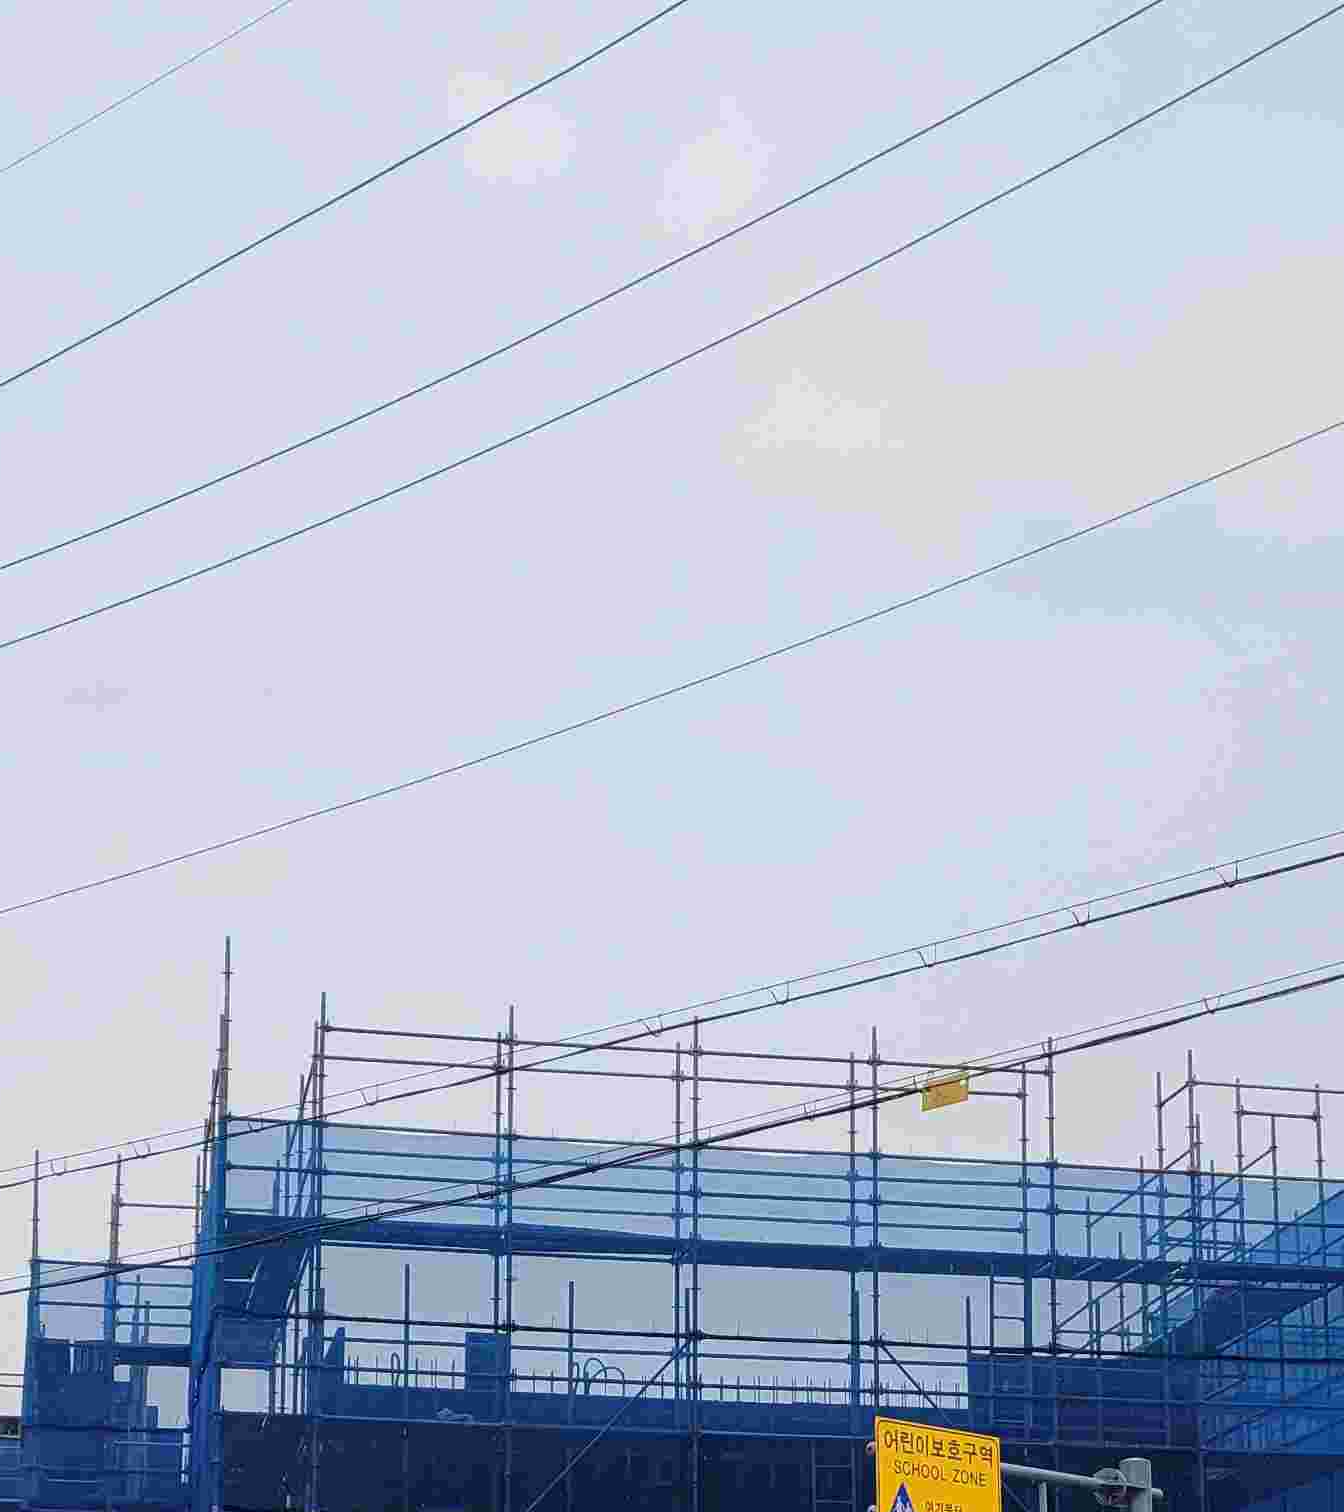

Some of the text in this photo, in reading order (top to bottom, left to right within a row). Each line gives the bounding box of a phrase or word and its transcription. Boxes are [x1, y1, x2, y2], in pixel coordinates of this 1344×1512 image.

[884, 1430, 994, 1469] 어린이보호구역
[894, 1459, 987, 1488] SCHOOL ZONE
